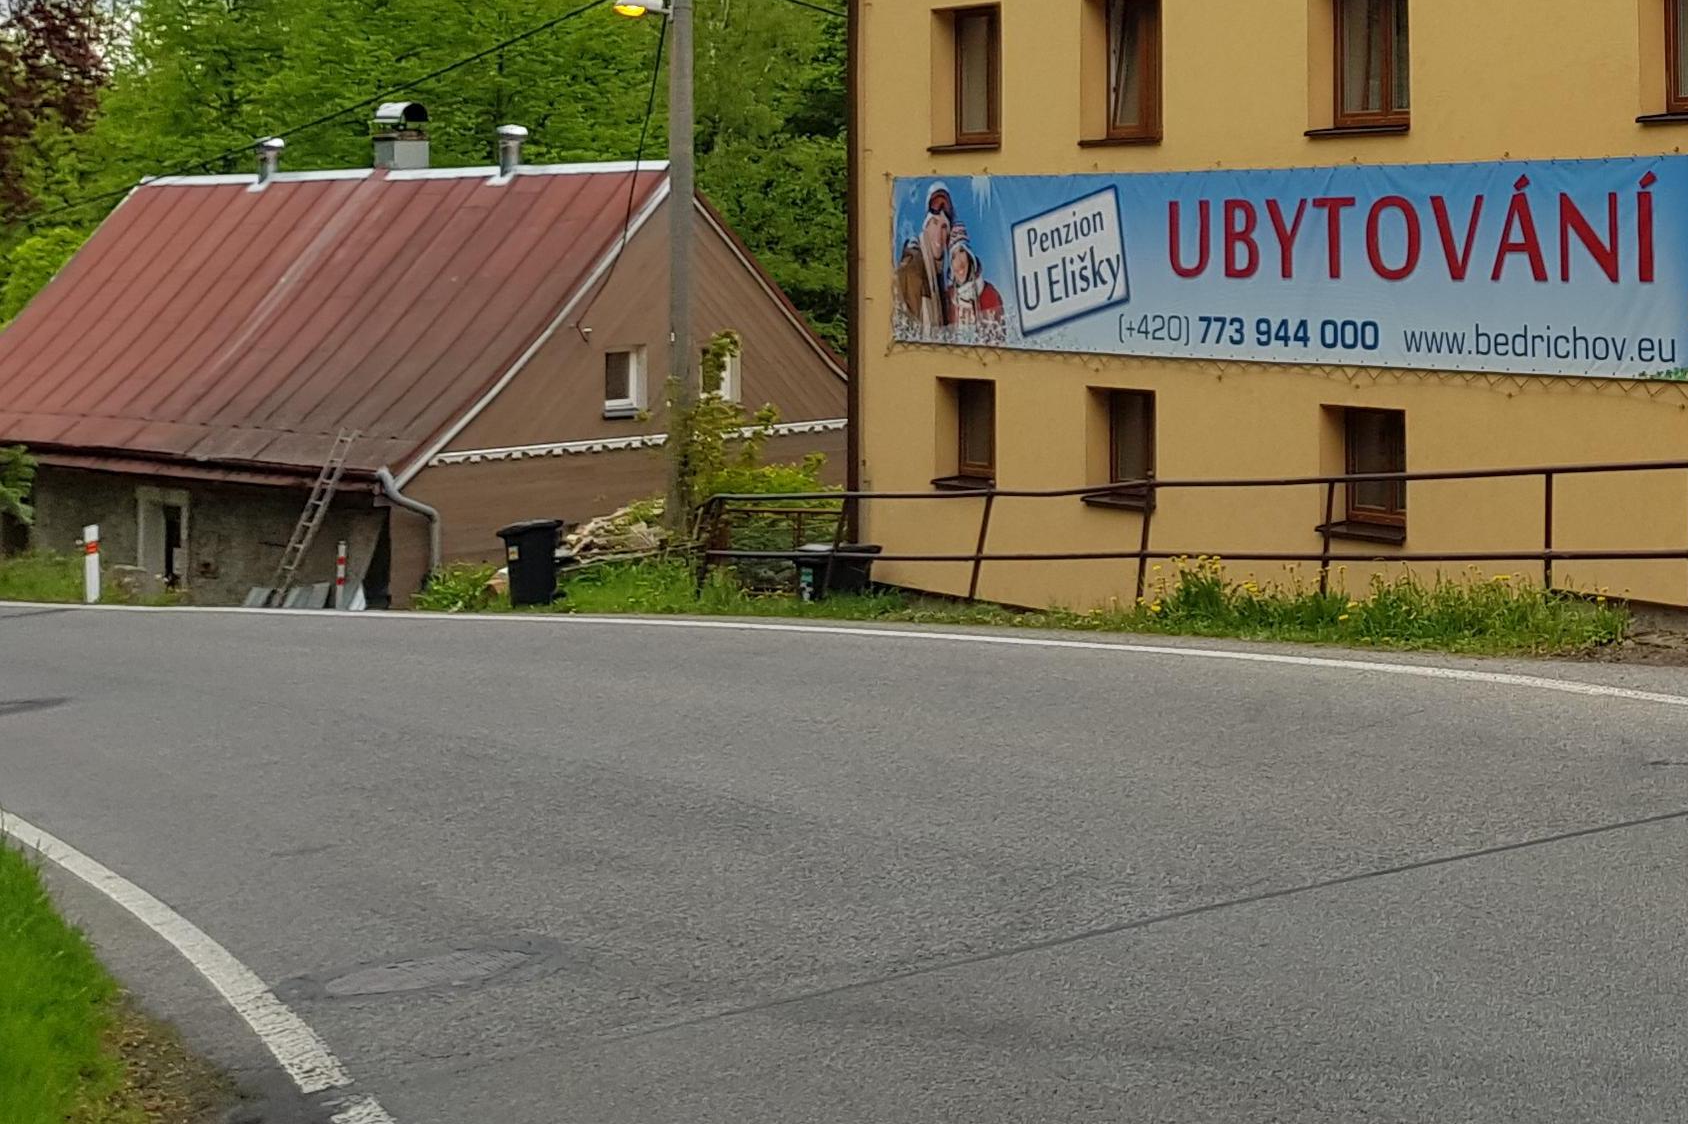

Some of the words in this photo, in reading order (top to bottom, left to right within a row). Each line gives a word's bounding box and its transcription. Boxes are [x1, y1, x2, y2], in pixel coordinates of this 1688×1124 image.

[1026, 210, 1105, 258] Penzion
[1167, 170, 1658, 281] UBYTOVÁNÍ
[1022, 271, 1040, 311] U
[1046, 245, 1121, 301] Elišky
[1118, 313, 1190, 346] (+420)
[1199, 316, 1245, 346] 773
[1255, 318, 1311, 348] 944
[1320, 319, 1380, 351] 000
[1403, 323, 1677, 364] www.bedrichov.eu
